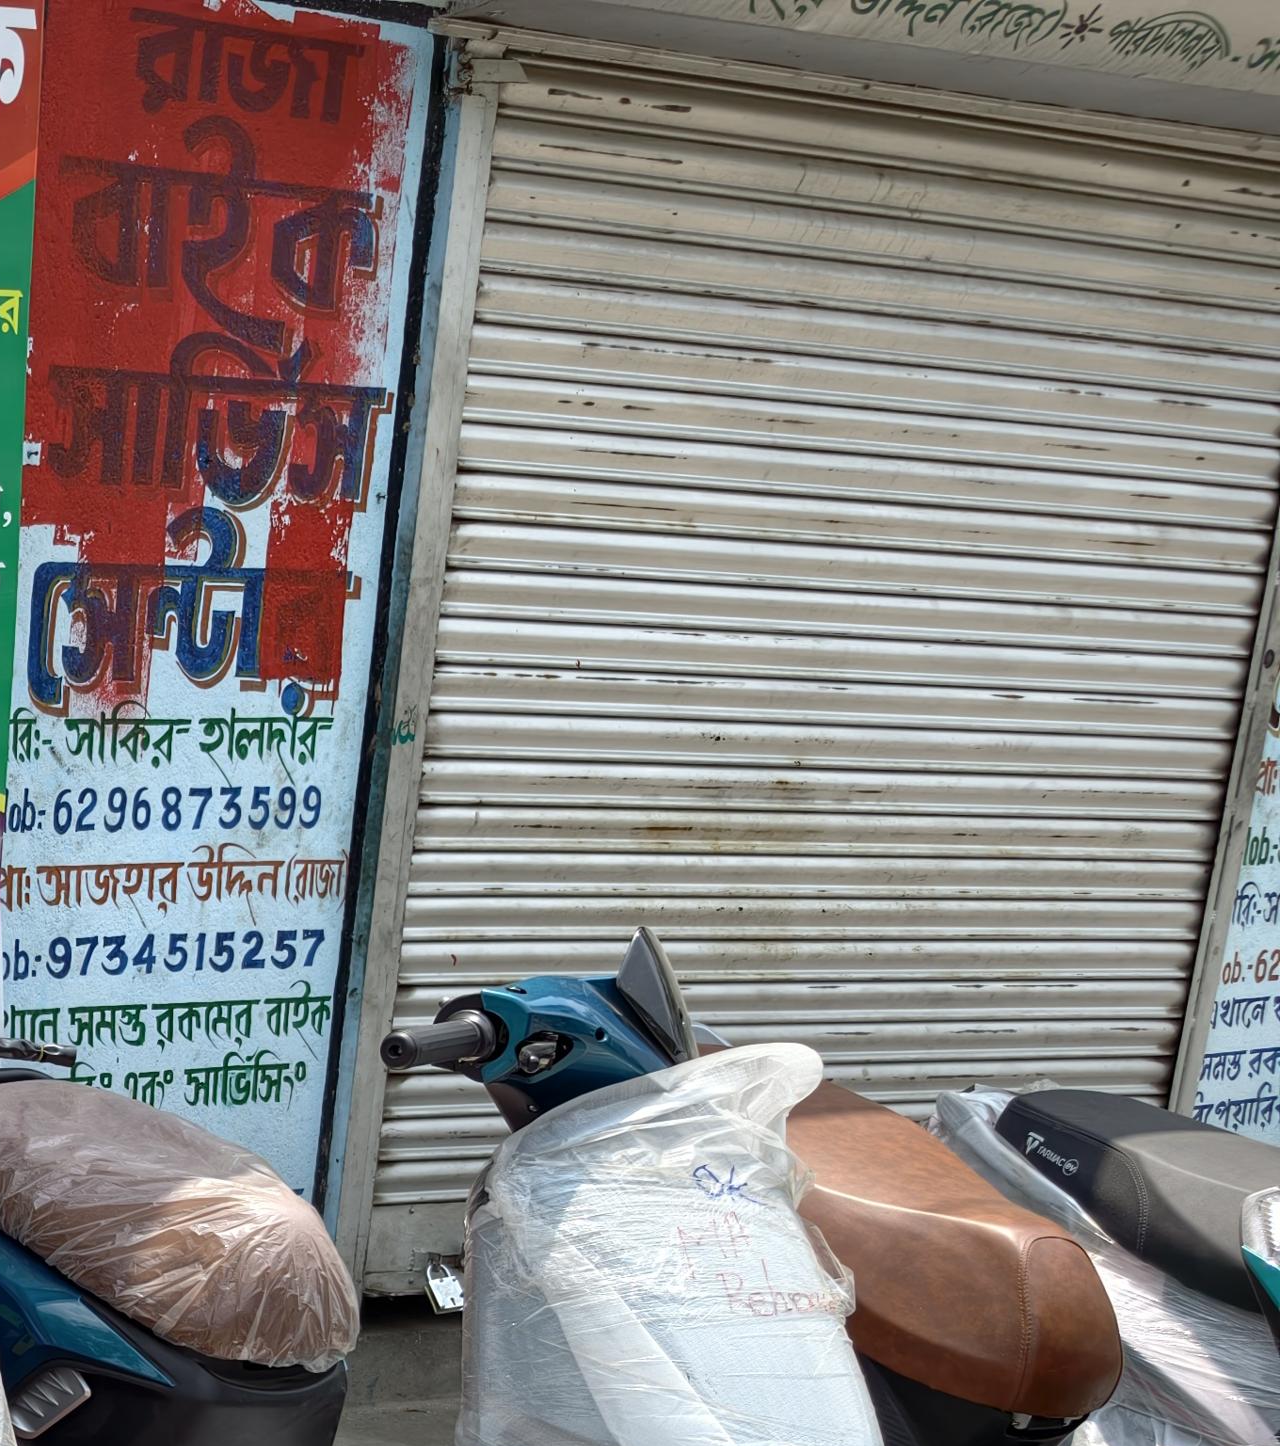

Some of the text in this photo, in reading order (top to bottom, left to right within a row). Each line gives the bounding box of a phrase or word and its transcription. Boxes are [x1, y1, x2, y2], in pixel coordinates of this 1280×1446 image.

[135, 8, 366, 125] রাজা
[60, 118, 384, 350] বাইক
[45, 331, 392, 510] সার্ভিস
[199, 707, 334, 786] হালদার
[264, 980, 332, 1058] বাইক
